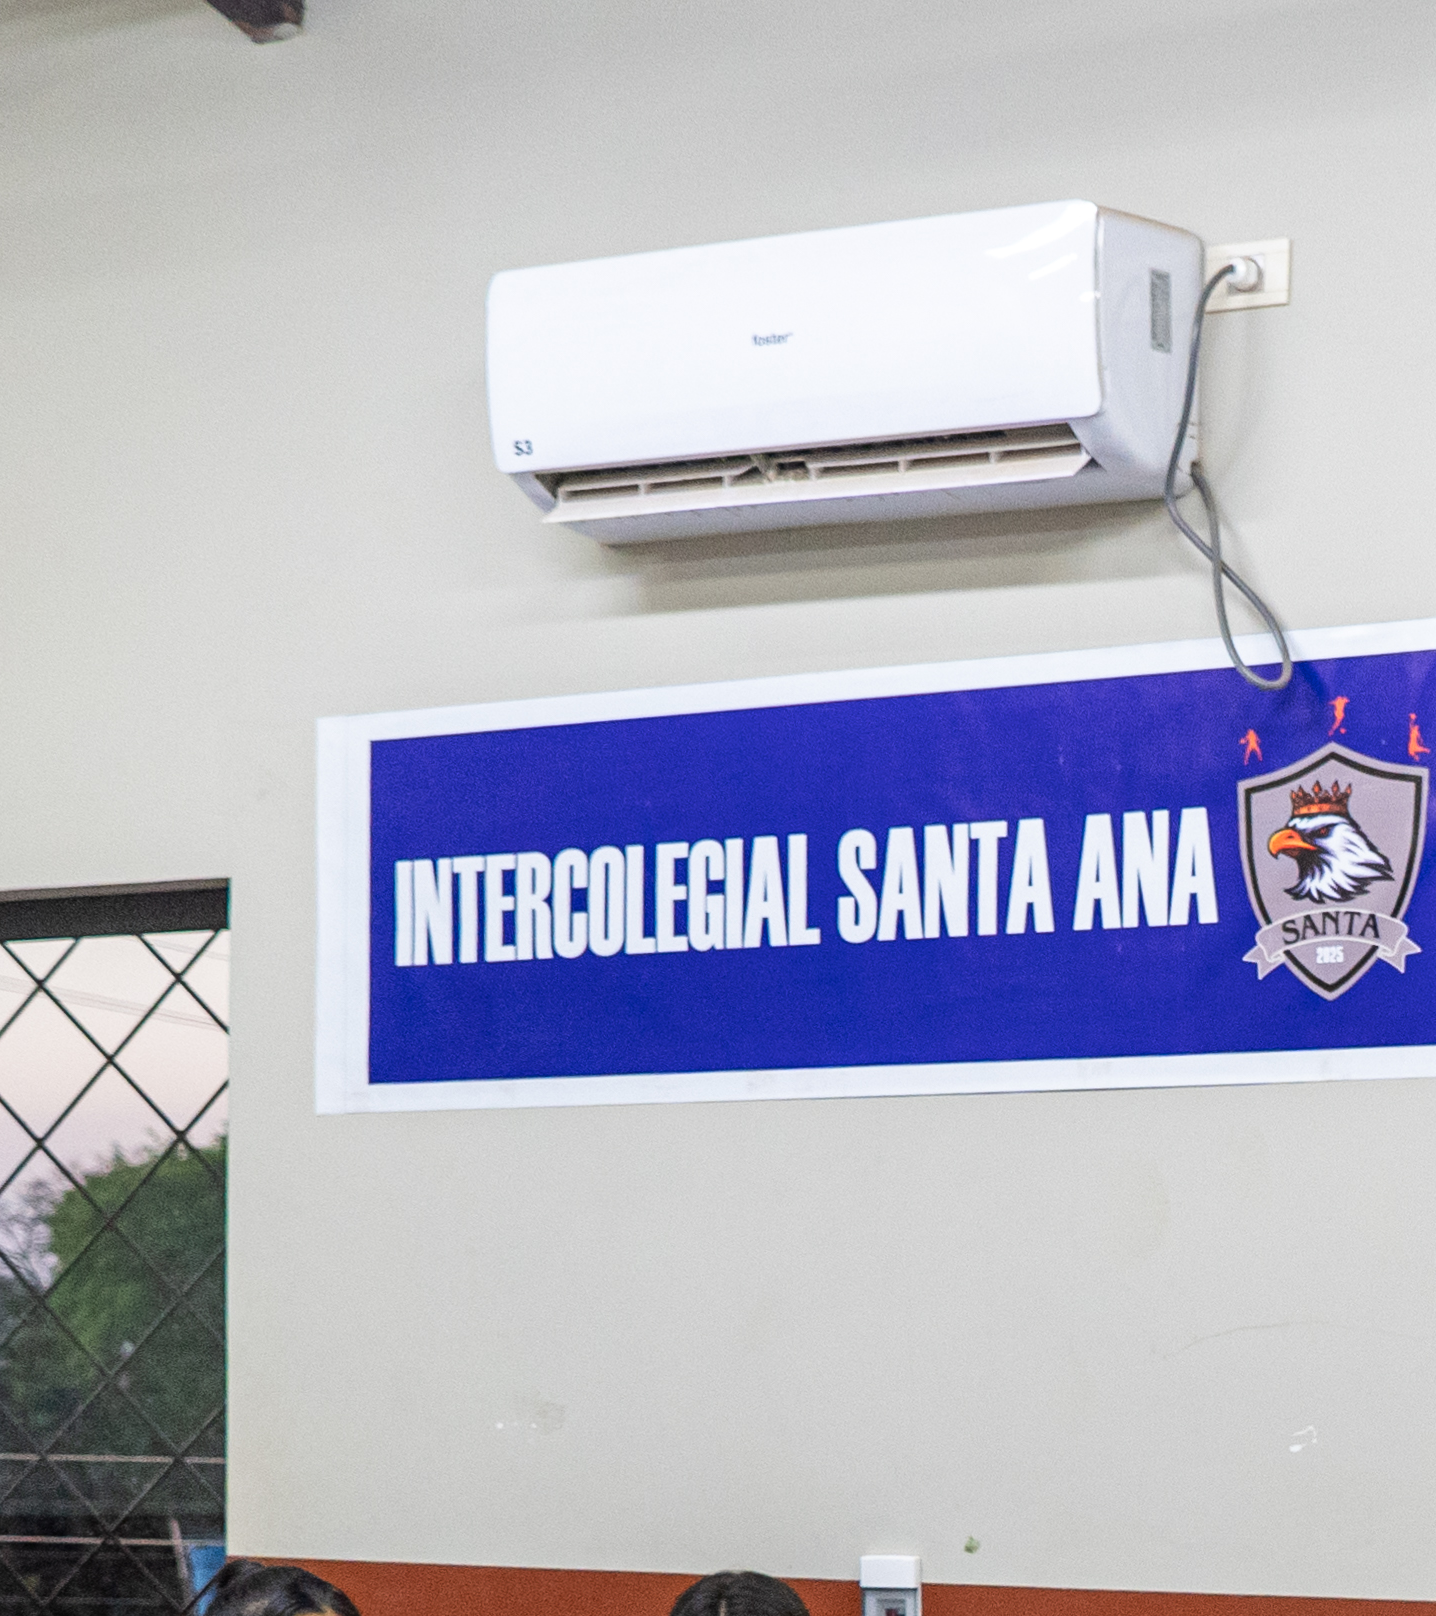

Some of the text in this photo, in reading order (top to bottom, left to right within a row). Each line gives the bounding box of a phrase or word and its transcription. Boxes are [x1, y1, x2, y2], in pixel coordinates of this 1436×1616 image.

[395, 806, 1220, 967] INTERCOLEGIAL SANTA ANA
[1281, 910, 1381, 945] SANTA
